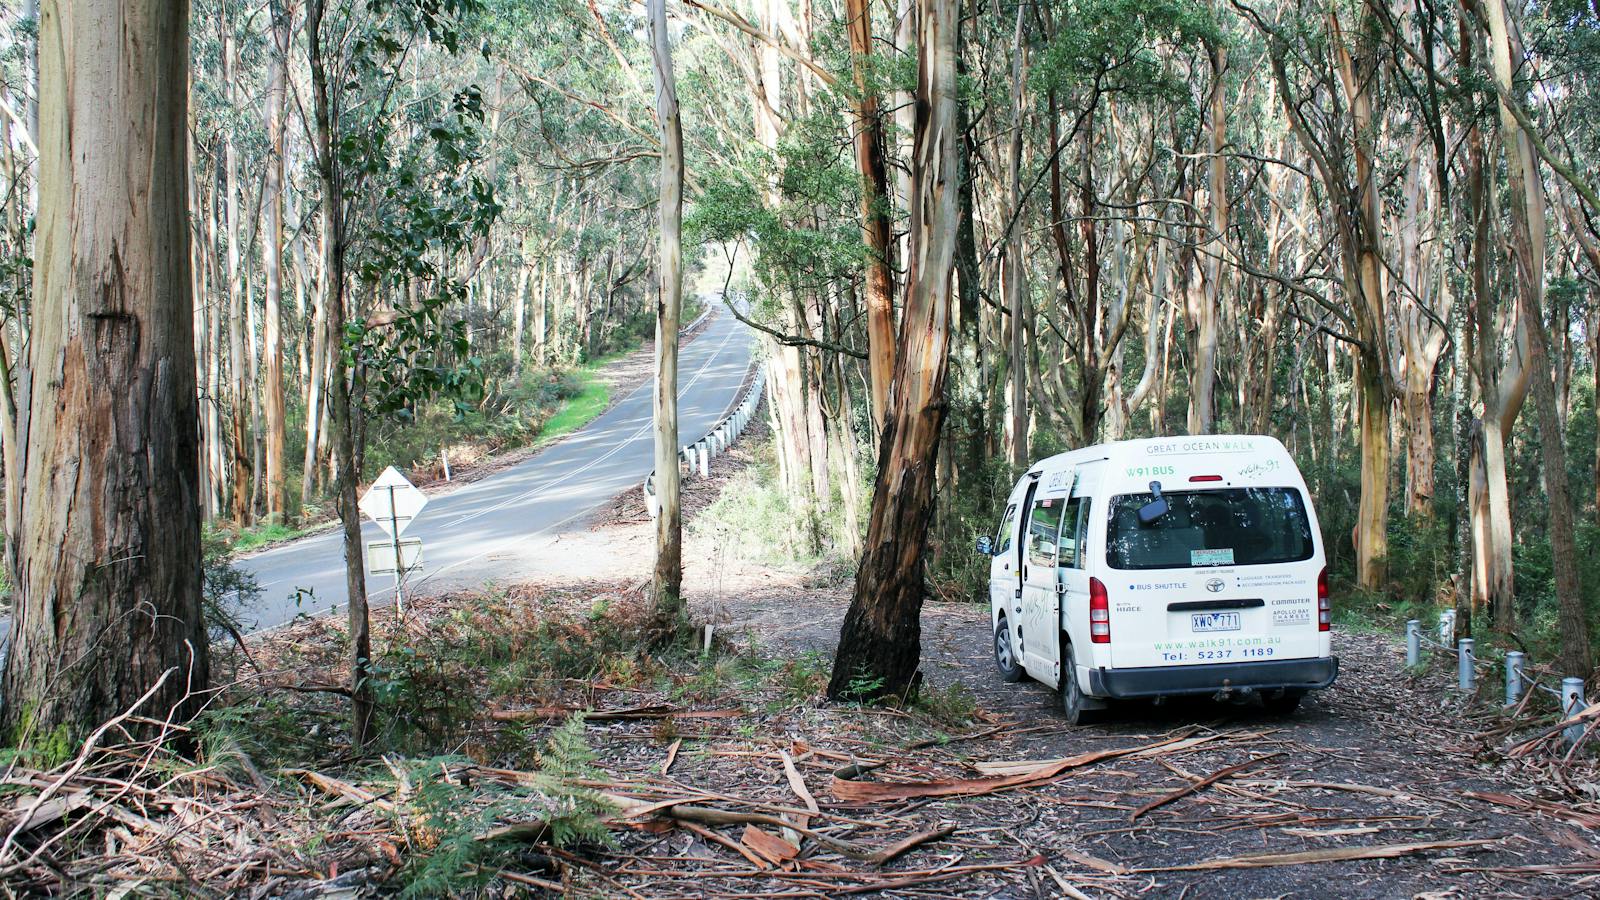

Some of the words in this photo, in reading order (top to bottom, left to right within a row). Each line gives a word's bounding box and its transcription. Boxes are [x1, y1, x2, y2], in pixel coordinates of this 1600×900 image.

[1146, 444, 1176, 454] GREAT
[1183, 442, 1219, 451] OCEAN
[1223, 441, 1254, 450] WALK
[1193, 616, 1212, 628] XWQ
[1220, 615, 1238, 627] 771
[1154, 636, 1281, 650] www.walk91.com.au
[1162, 652, 1188, 661] Tel:
[1198, 650, 1232, 659] 5237
[1242, 647, 1274, 657] 1189
